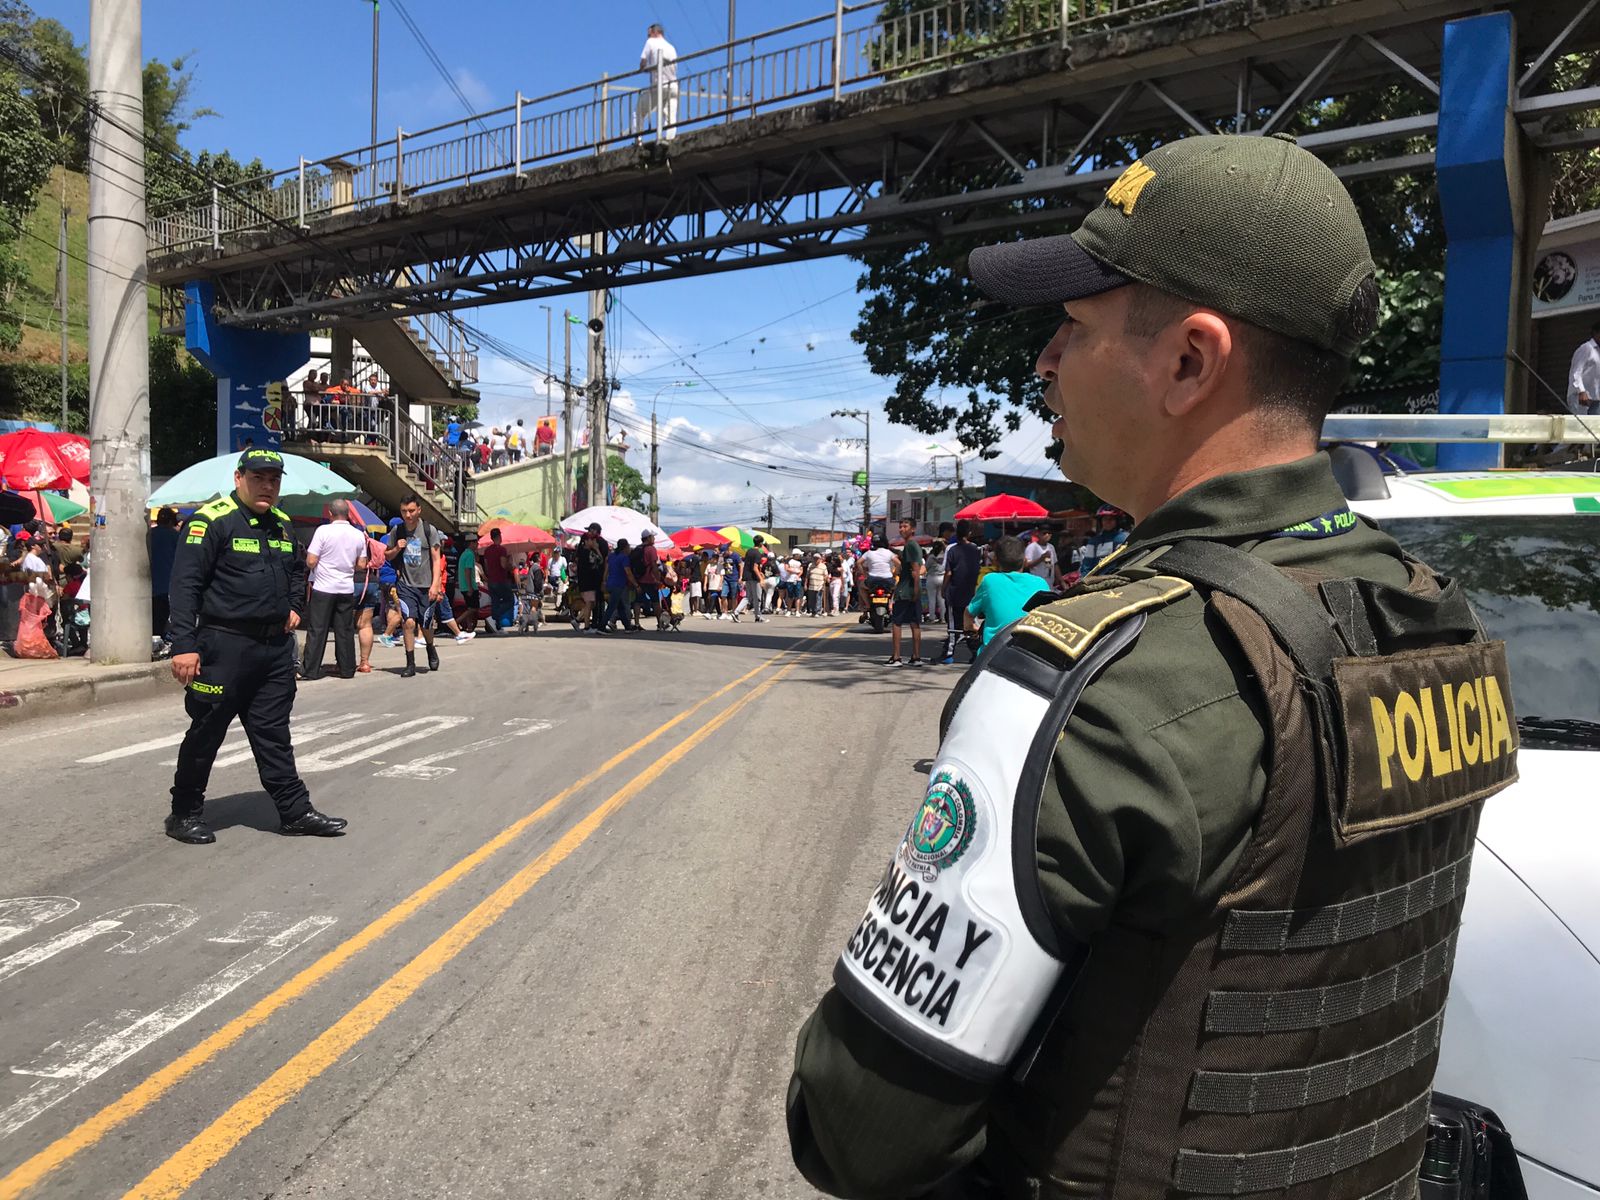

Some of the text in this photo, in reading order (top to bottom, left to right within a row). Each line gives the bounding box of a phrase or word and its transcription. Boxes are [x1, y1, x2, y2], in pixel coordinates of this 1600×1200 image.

[247, 449, 282, 462] POLICIA
[1370, 674, 1513, 790] POLICIA
[955, 919, 993, 970] Y
